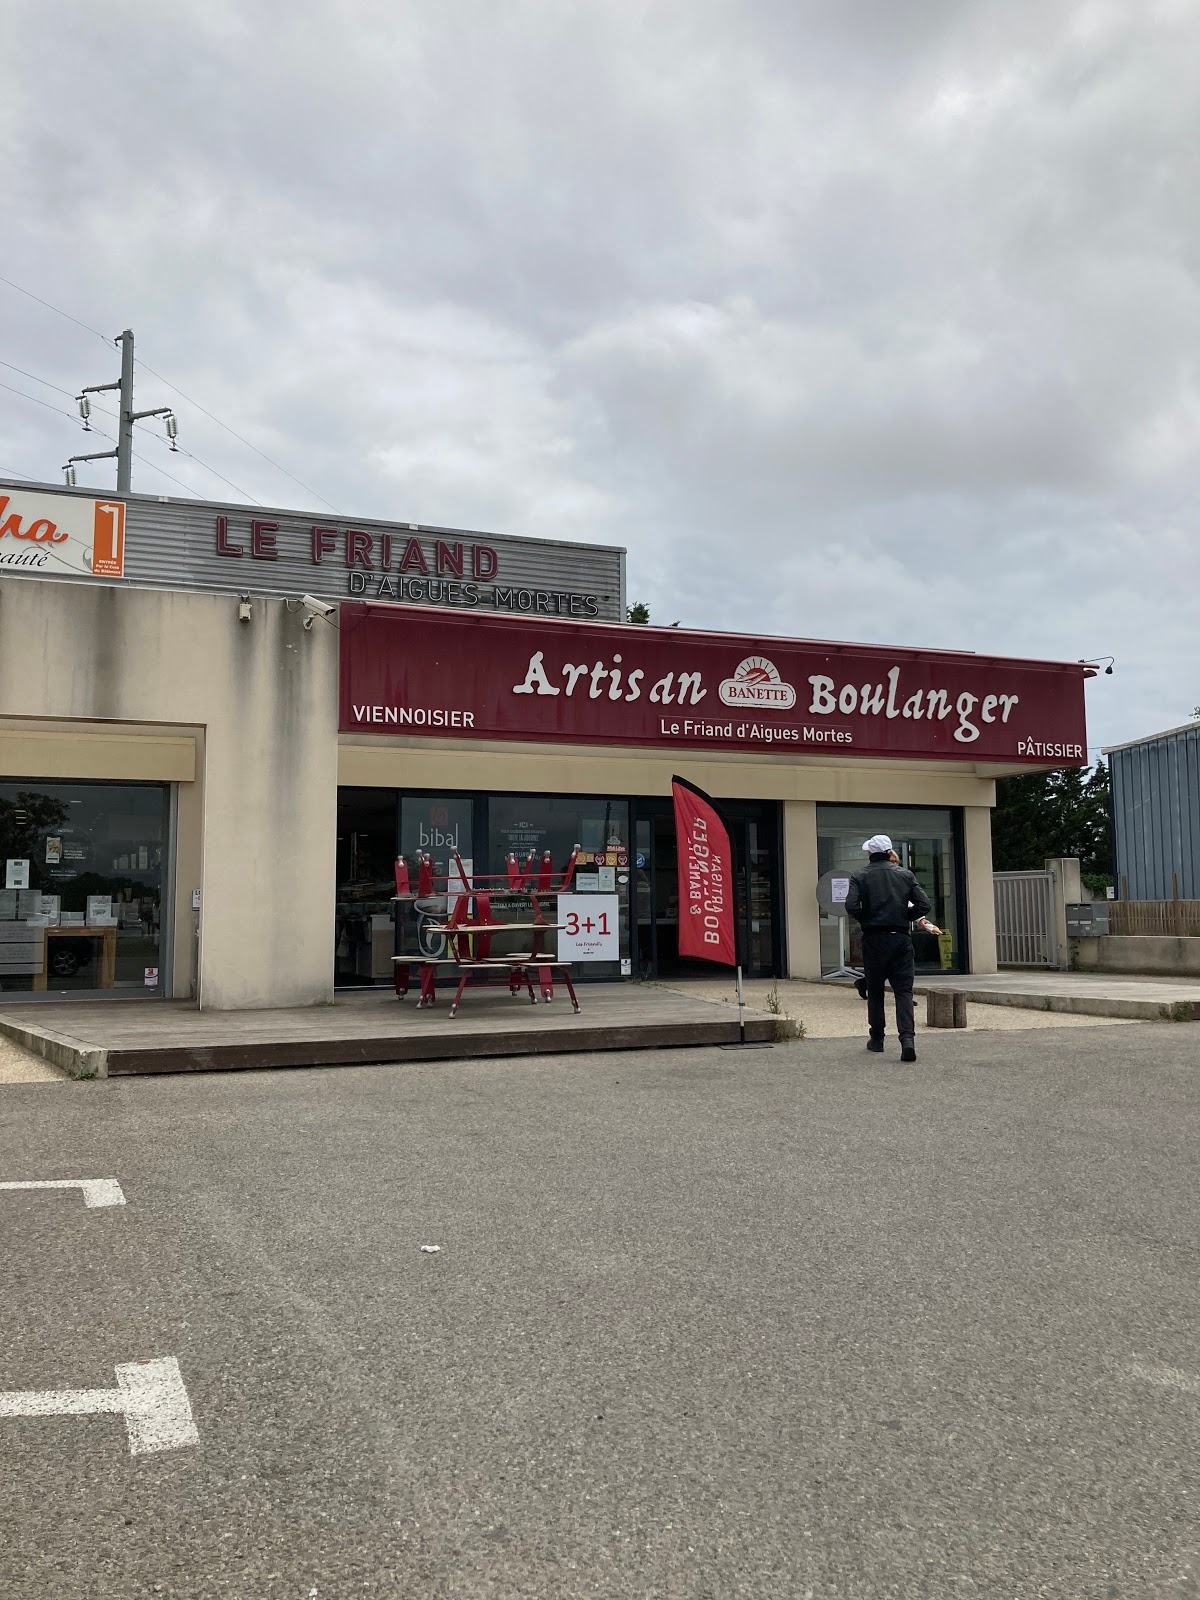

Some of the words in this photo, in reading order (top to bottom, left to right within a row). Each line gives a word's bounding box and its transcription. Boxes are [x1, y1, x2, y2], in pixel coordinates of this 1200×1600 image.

[216, 516, 279, 560] LE
[312, 526, 498, 580] FRIAND
[349, 572, 479, 605] D'AIGUES
[494, 587, 598, 616] MORTES
[513, 651, 707, 706] Artisan
[808, 666, 1019, 742] Boulanger
[728, 687, 788, 701] BANETTE
[353, 705, 475, 728] VIENNOISIER
[660, 719, 680, 734] Le
[684, 721, 732, 737] Friand
[737, 723, 798, 743] d'Aigues
[803, 727, 852, 743] Mortes
[1017, 736, 1083, 758] PÂTISSIER
[419, 822, 459, 847] bibal
[566, 912, 611, 936] 3+1
